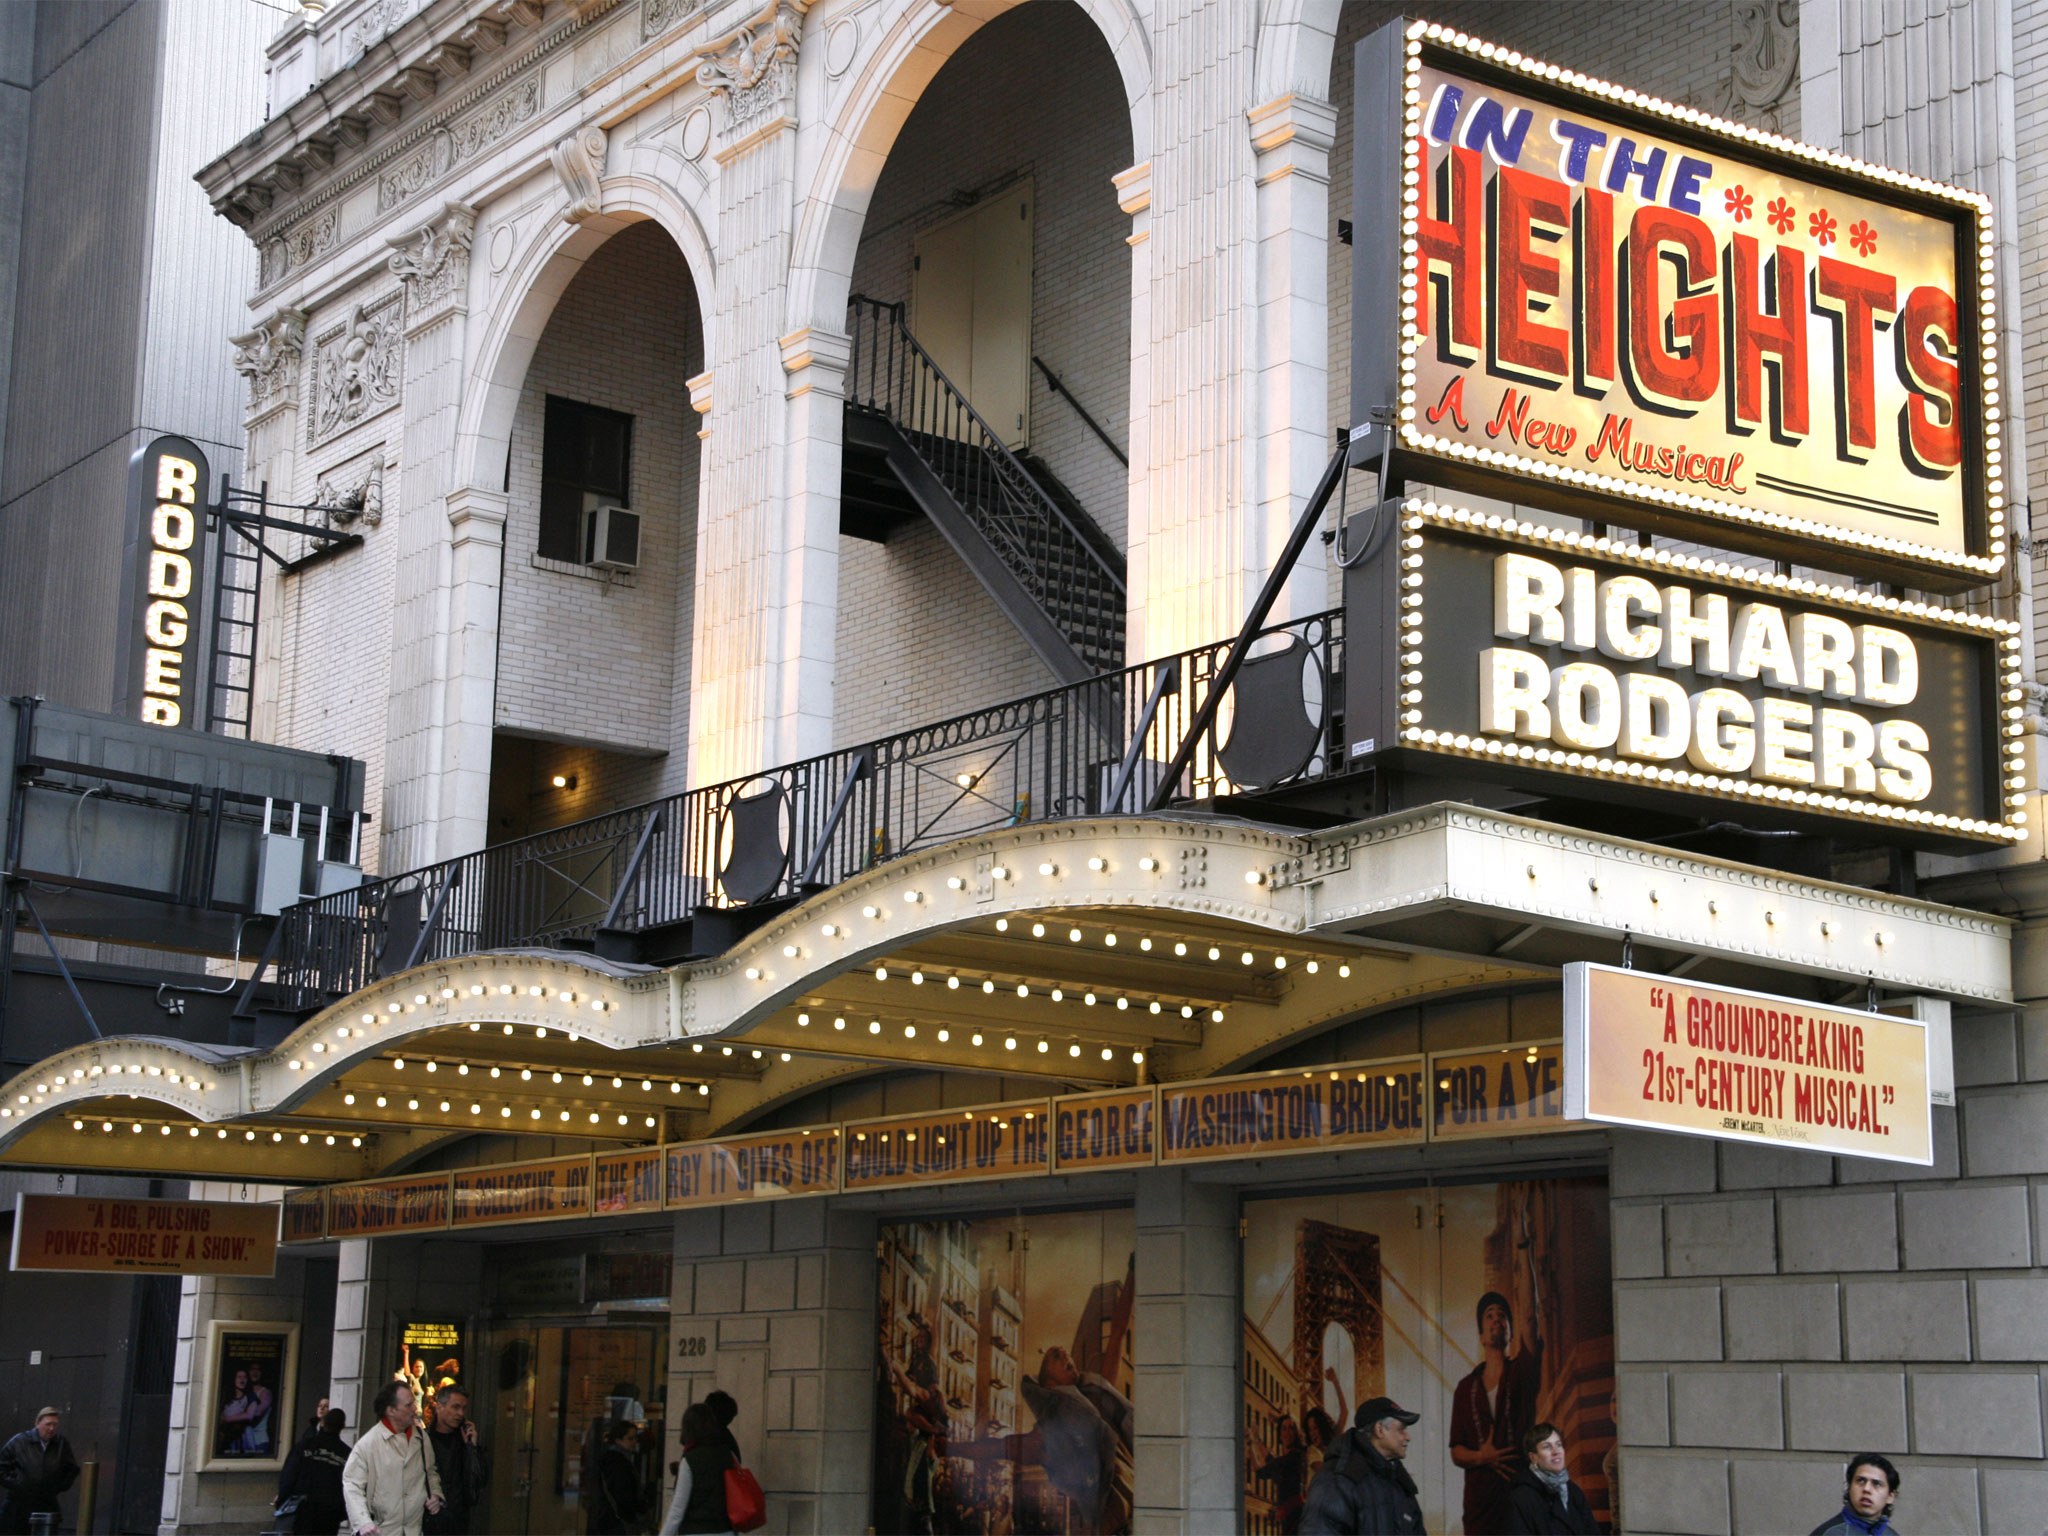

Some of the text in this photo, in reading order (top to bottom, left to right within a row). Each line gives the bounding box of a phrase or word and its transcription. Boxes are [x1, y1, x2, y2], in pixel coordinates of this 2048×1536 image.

[1426, 84, 1712, 216] IN THE
[1415, 135, 1962, 480] HEIGHTS
[1427, 376, 1748, 493] A New Musical
[1494, 552, 1919, 708] RICHARD
[1479, 647, 1933, 802] RODGERS
[1650, 987, 1865, 1075] “A GROUNDBREAKING
[475, 1167, 555, 1217] COLLECTIVE
[599, 1163, 628, 1206] THE
[710, 1151, 727, 1195] IT
[737, 1142, 794, 1192] GIVES
[801, 1136, 838, 1186] OFF
[847, 1128, 908, 1180] COULD
[913, 1121, 971, 1174] LIGHT
[976, 1118, 1002, 1169] UP
[1010, 1113, 1048, 1166] THE
[1060, 1101, 1153, 1160] GEORGE
[1163, 1081, 1322, 1150] WASHINGTON
[1331, 1070, 1423, 1137] BRIDGE
[1435, 1063, 1487, 1126] FOR
[1497, 1059, 1516, 1122] A
[1794, 1072, 1895, 1136] MUSICAL.”
[44, 1229, 256, 1262] POWER-SURGE OF A SHOW.”
[87, 1203, 210, 1232] “A BIG, PULSING
